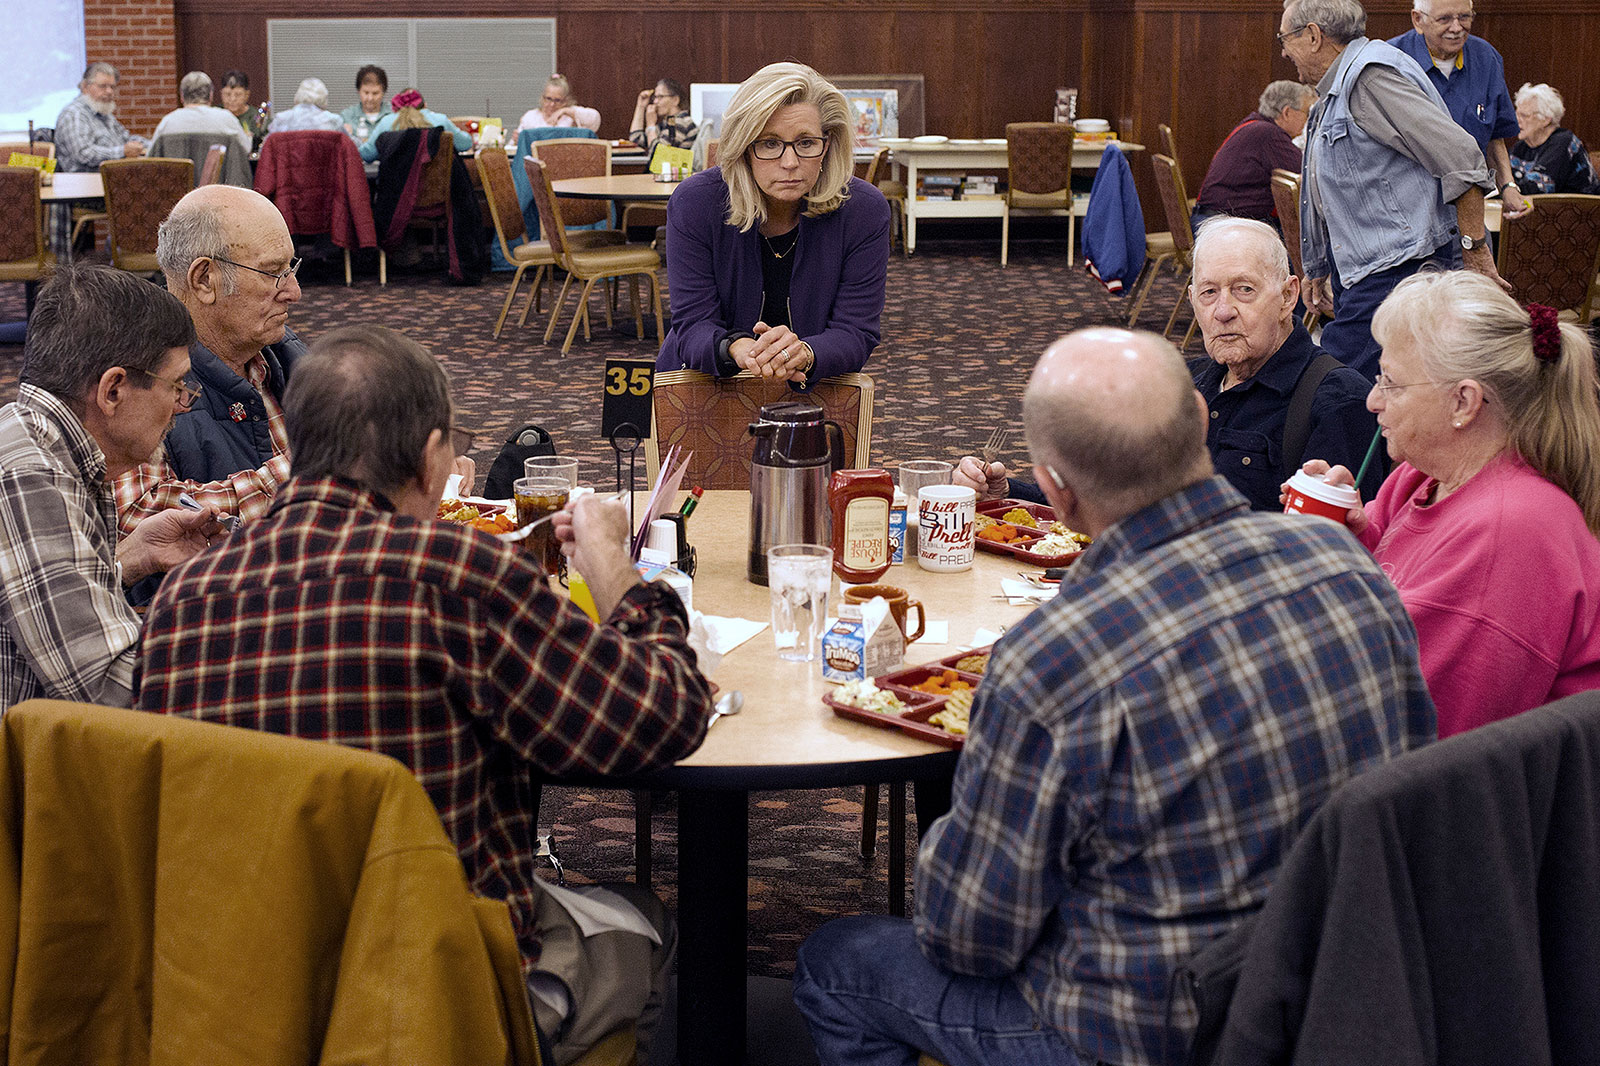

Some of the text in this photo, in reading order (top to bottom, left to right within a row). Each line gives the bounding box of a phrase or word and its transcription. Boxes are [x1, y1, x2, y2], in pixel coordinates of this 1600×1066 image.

[606, 367, 651, 396] 35
[932, 502, 959, 513] bill
[920, 510, 965, 530] Bill
[928, 521, 973, 543] Prell
[851, 538, 882, 549] RECIPE
[850, 547, 882, 559] HOUSE
[921, 550, 938, 560] Bill
[823, 644, 861, 666] TruMoo
